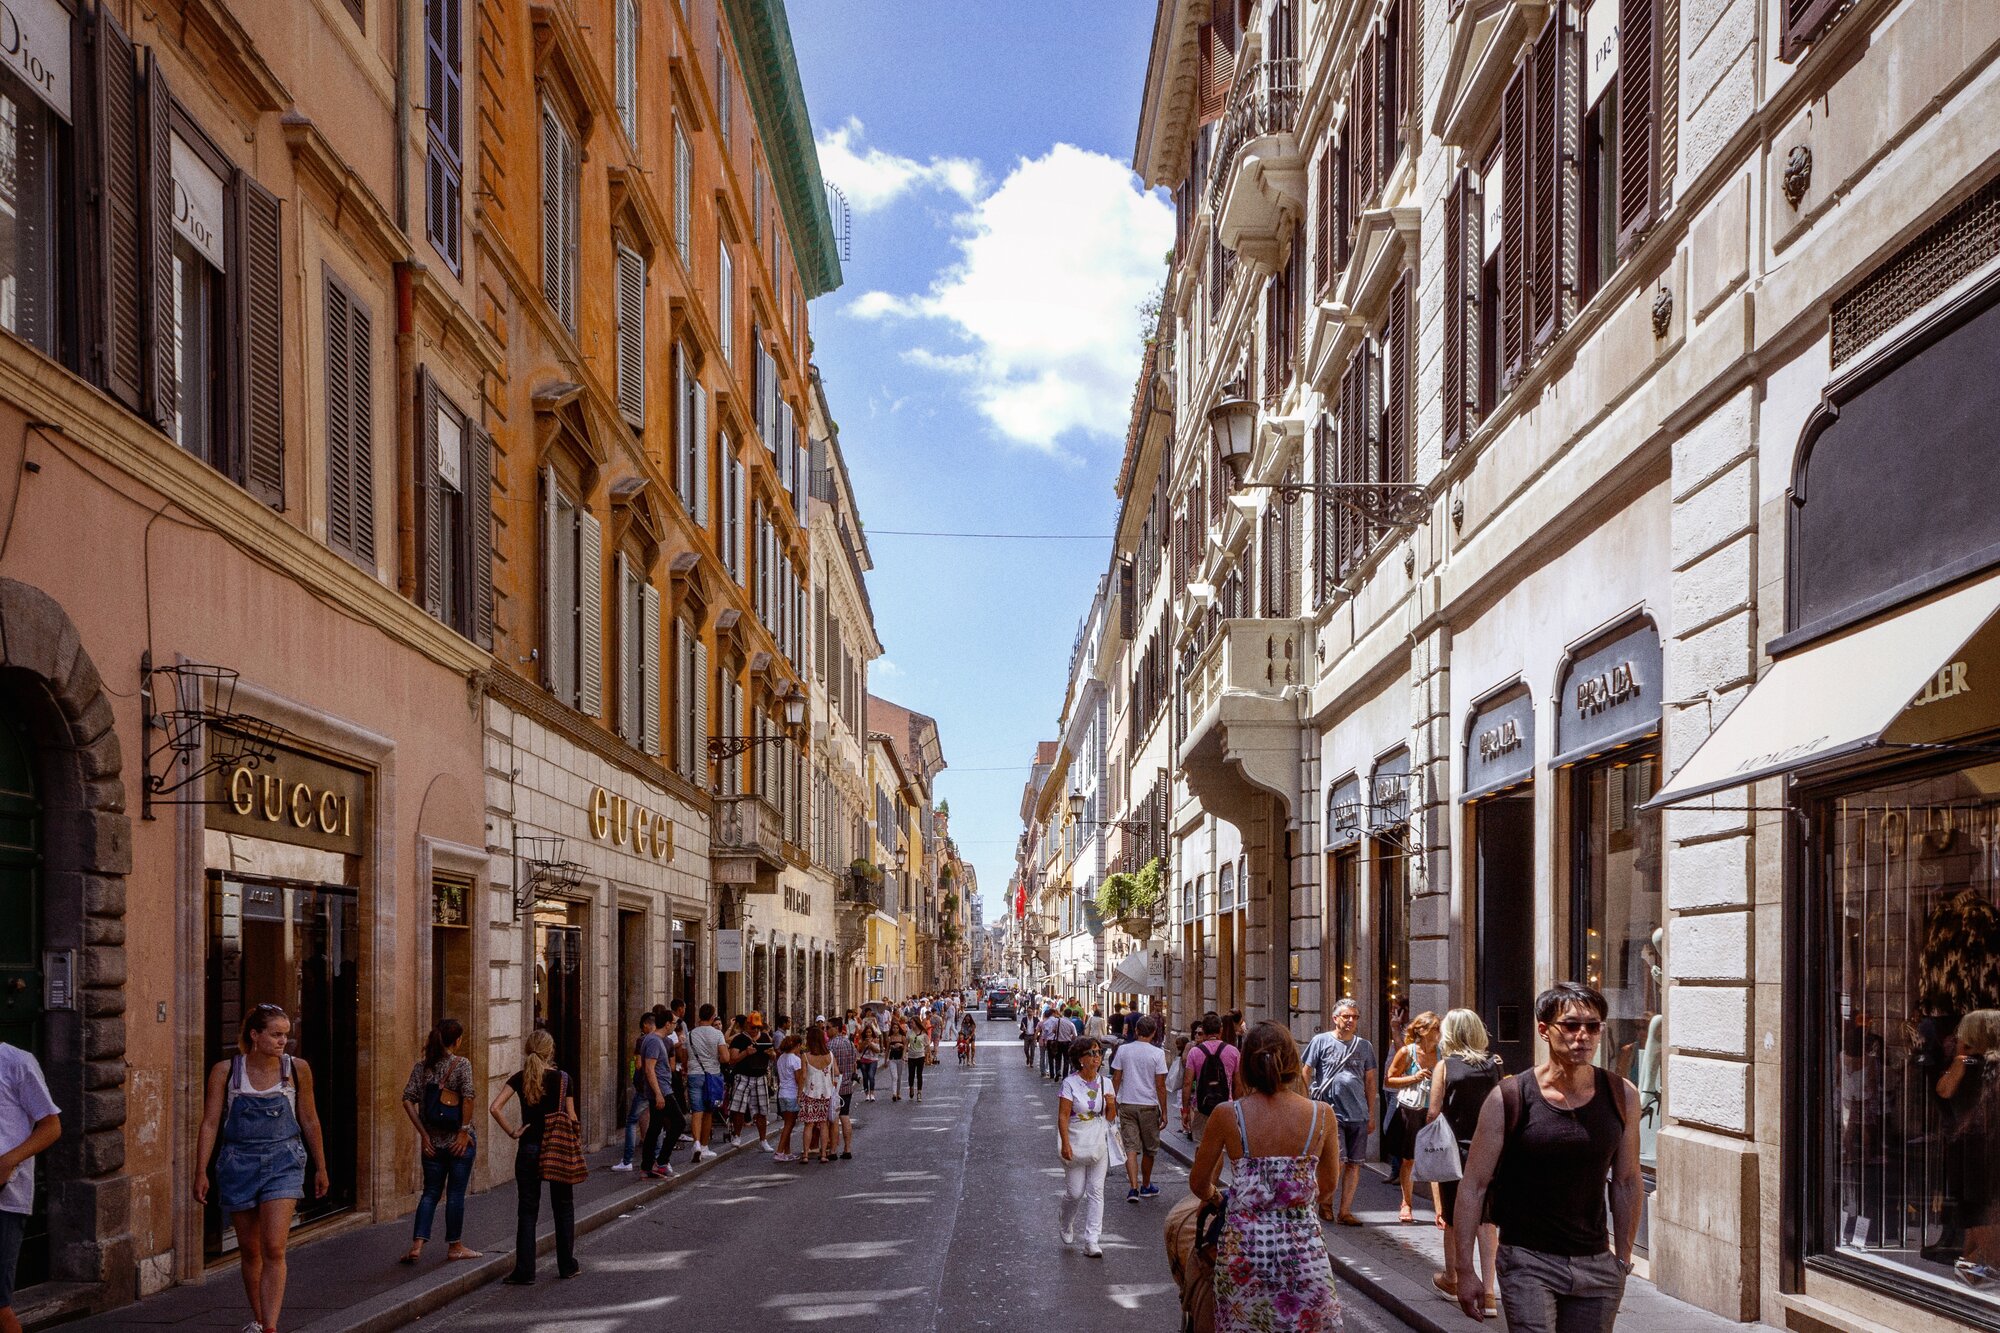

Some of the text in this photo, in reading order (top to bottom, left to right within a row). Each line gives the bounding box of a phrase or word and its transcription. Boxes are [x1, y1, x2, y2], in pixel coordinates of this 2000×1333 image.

[172, 177, 213, 251] Dior
[1578, 662, 1639, 717] PRADA
[1913, 661, 1971, 706] LER
[1480, 719, 1522, 760] PRADA
[227, 767, 350, 836] GUCCI
[589, 786, 674, 862] GUCCI
[784, 884, 811, 916] BVLGARI
